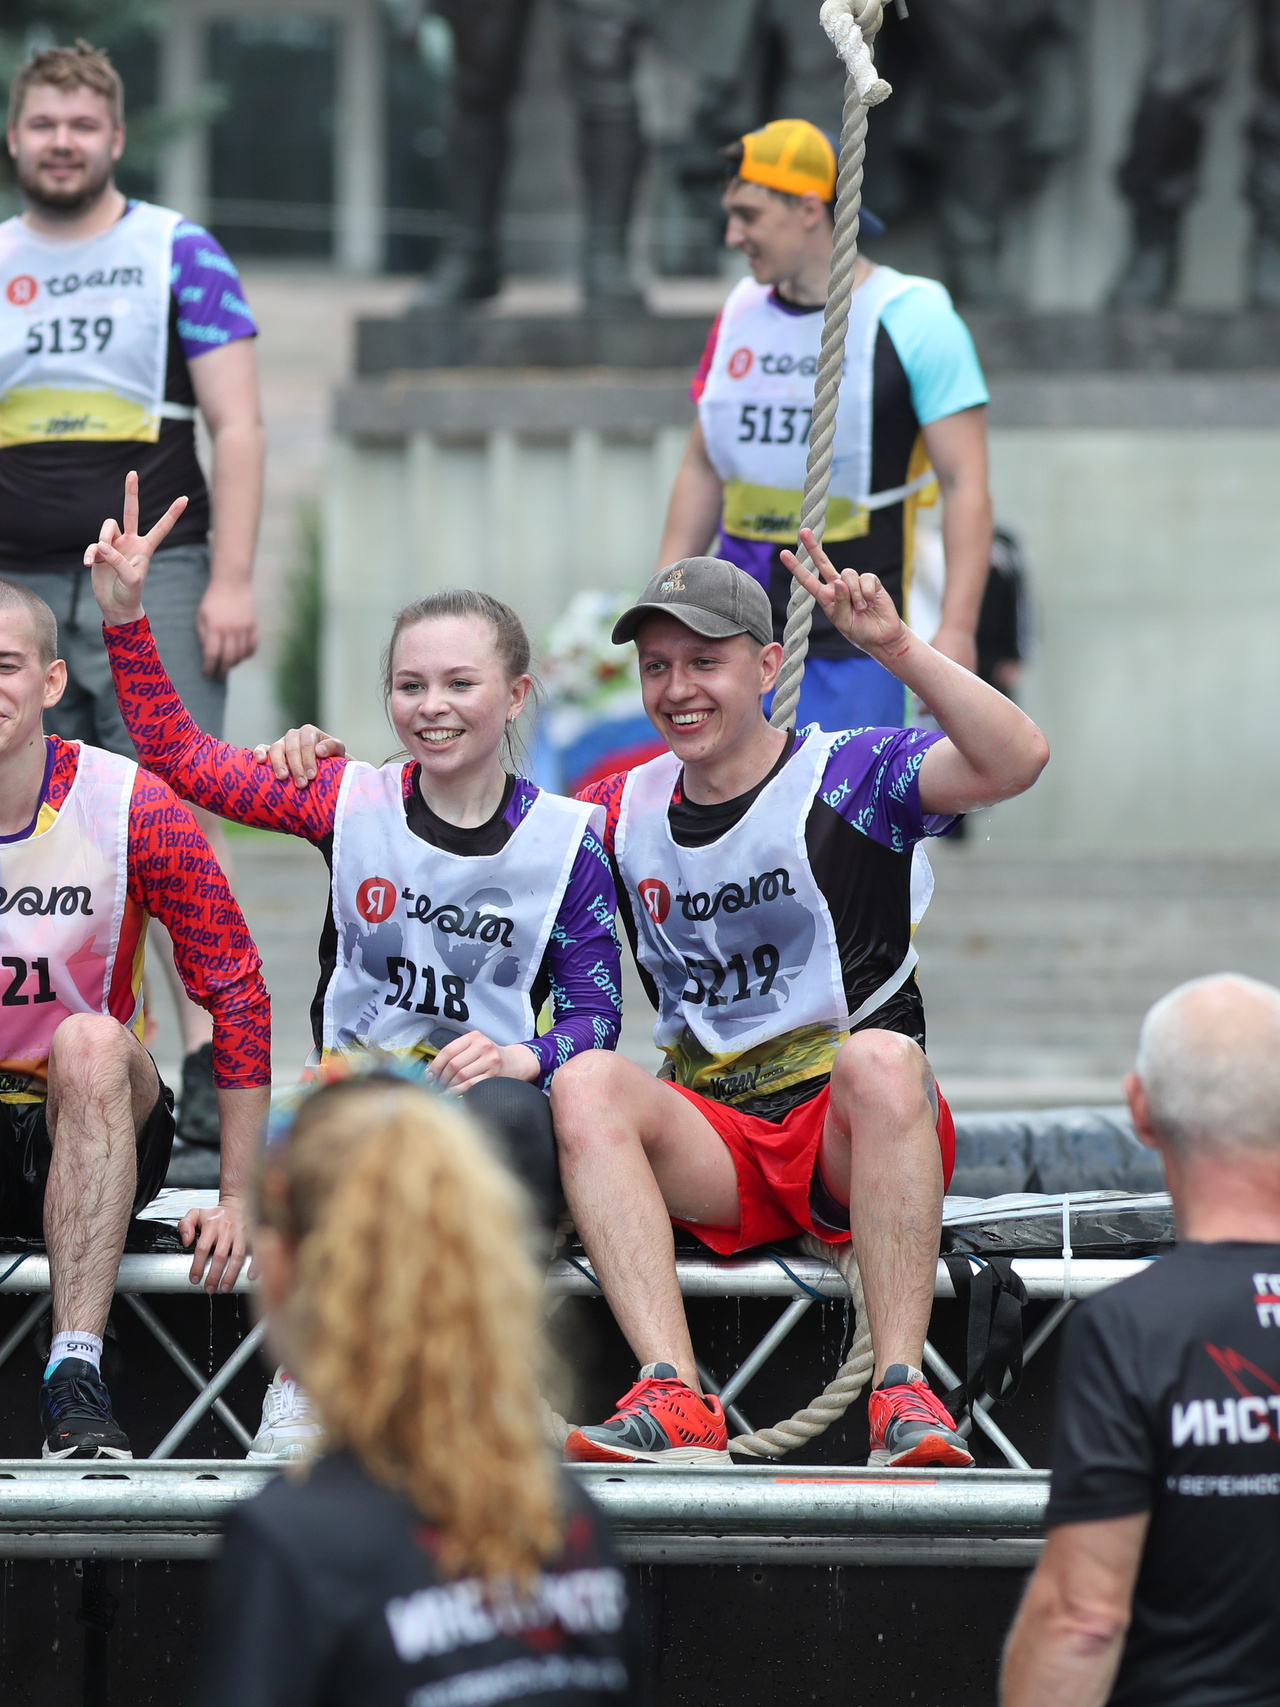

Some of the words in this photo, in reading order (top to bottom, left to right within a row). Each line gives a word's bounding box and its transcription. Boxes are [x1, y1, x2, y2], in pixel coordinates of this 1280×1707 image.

[44, 265, 146, 297] team
[26, 316, 114, 356] 5139
[759, 350, 847, 378] tea
[738, 406, 813, 447] 5137
[365, 886, 386, 915] Я
[401, 887, 515, 948] team
[676, 867, 797, 922] team
[384, 956, 470, 1023] 5218
[681, 943, 781, 1008] 5219
